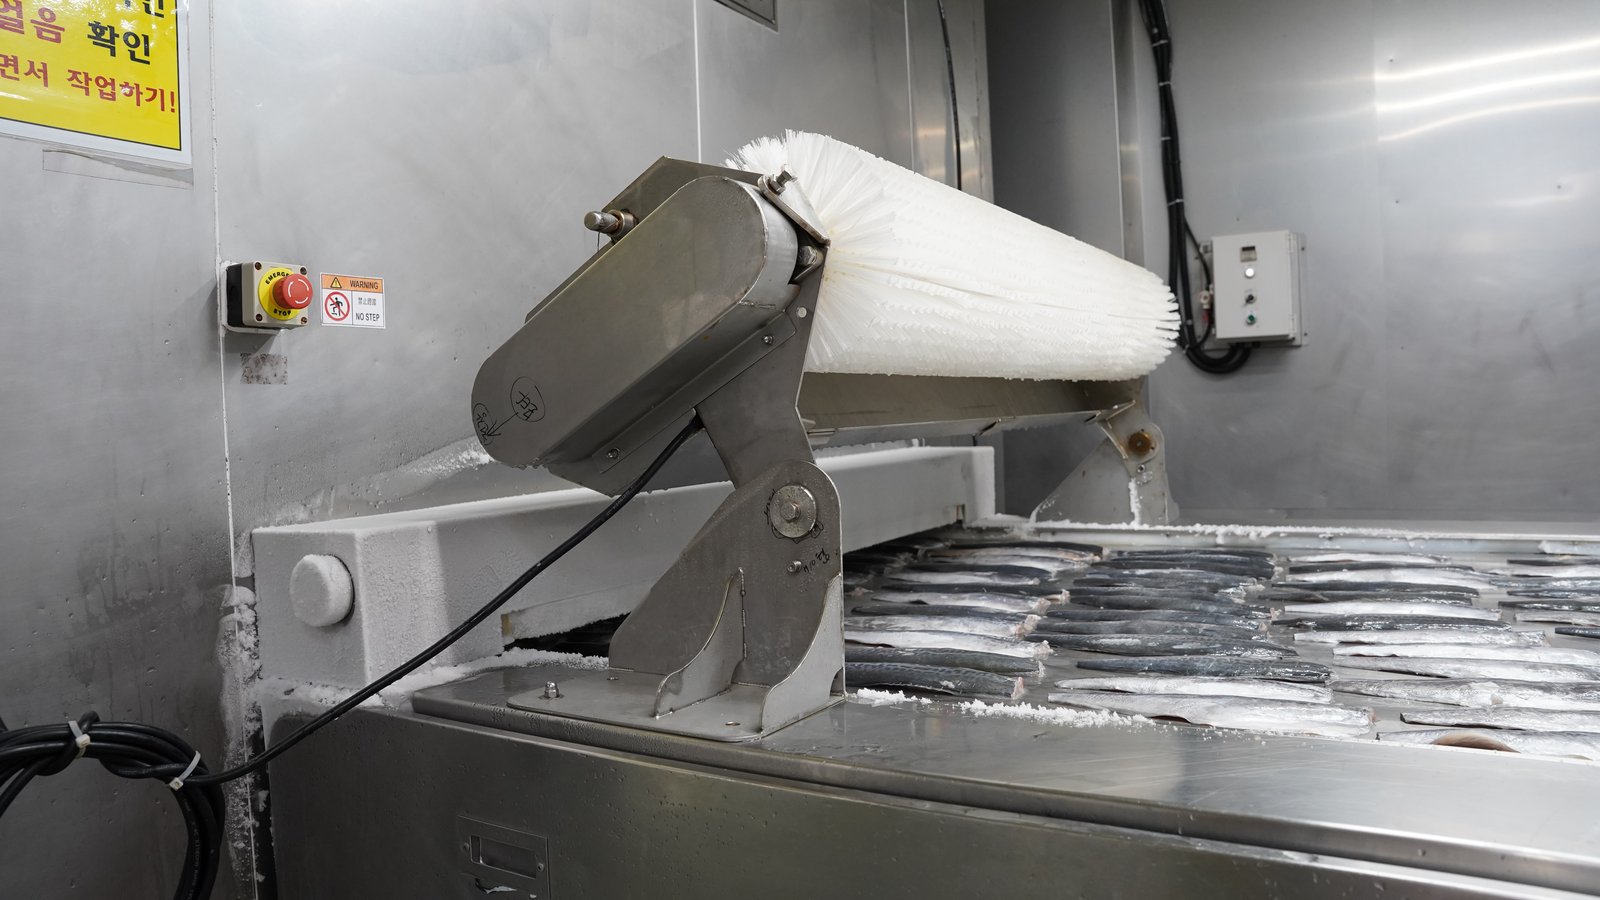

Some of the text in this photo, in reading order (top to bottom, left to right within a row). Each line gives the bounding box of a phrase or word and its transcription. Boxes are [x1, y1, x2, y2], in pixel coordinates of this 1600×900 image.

[87, 20, 150, 65] 확인
[0, 53, 175, 113] 면서 작업하기!
[349, 279, 379, 290] WARNING
[273, 308, 292, 317] STOP
[355, 312, 380, 322] NO STEP
